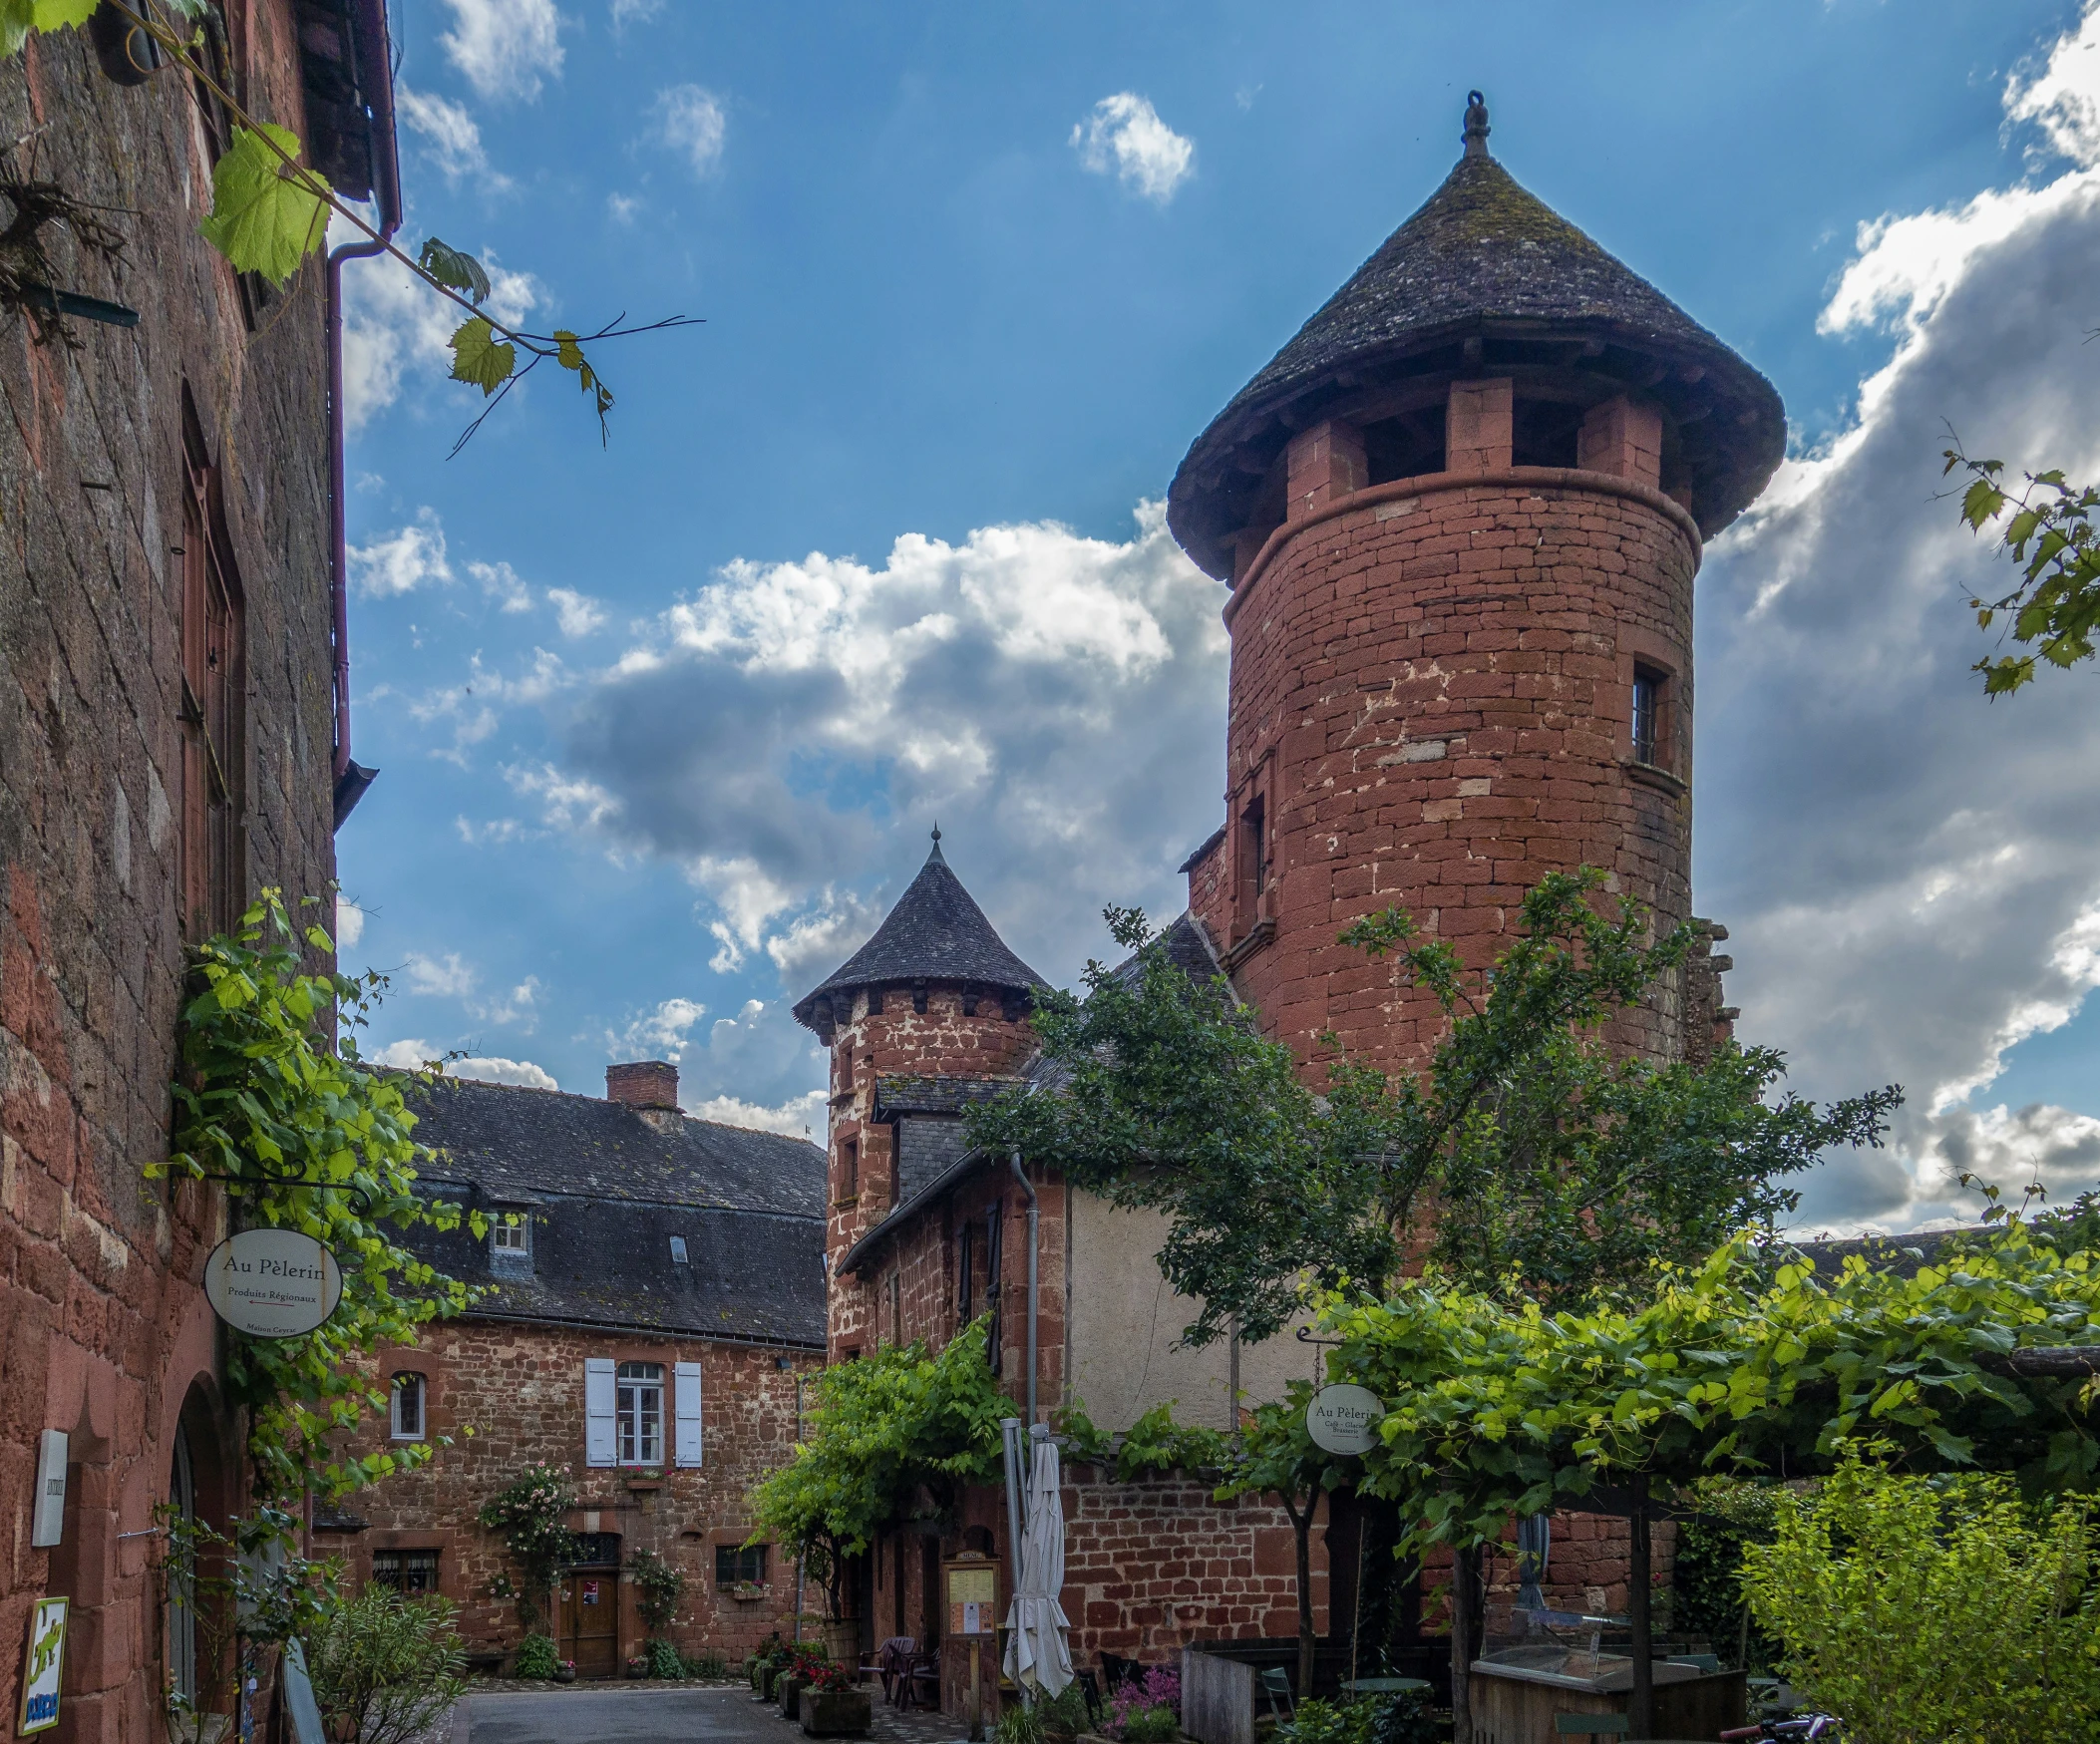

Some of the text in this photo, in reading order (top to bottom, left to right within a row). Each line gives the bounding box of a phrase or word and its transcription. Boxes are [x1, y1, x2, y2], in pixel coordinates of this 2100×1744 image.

[223, 1255, 325, 1280] Au Pèlerin
[228, 1286, 317, 1303] Produits Régionaux
[246, 1322, 271, 1332] Maison
[1316, 1406, 1332, 1417] Au
